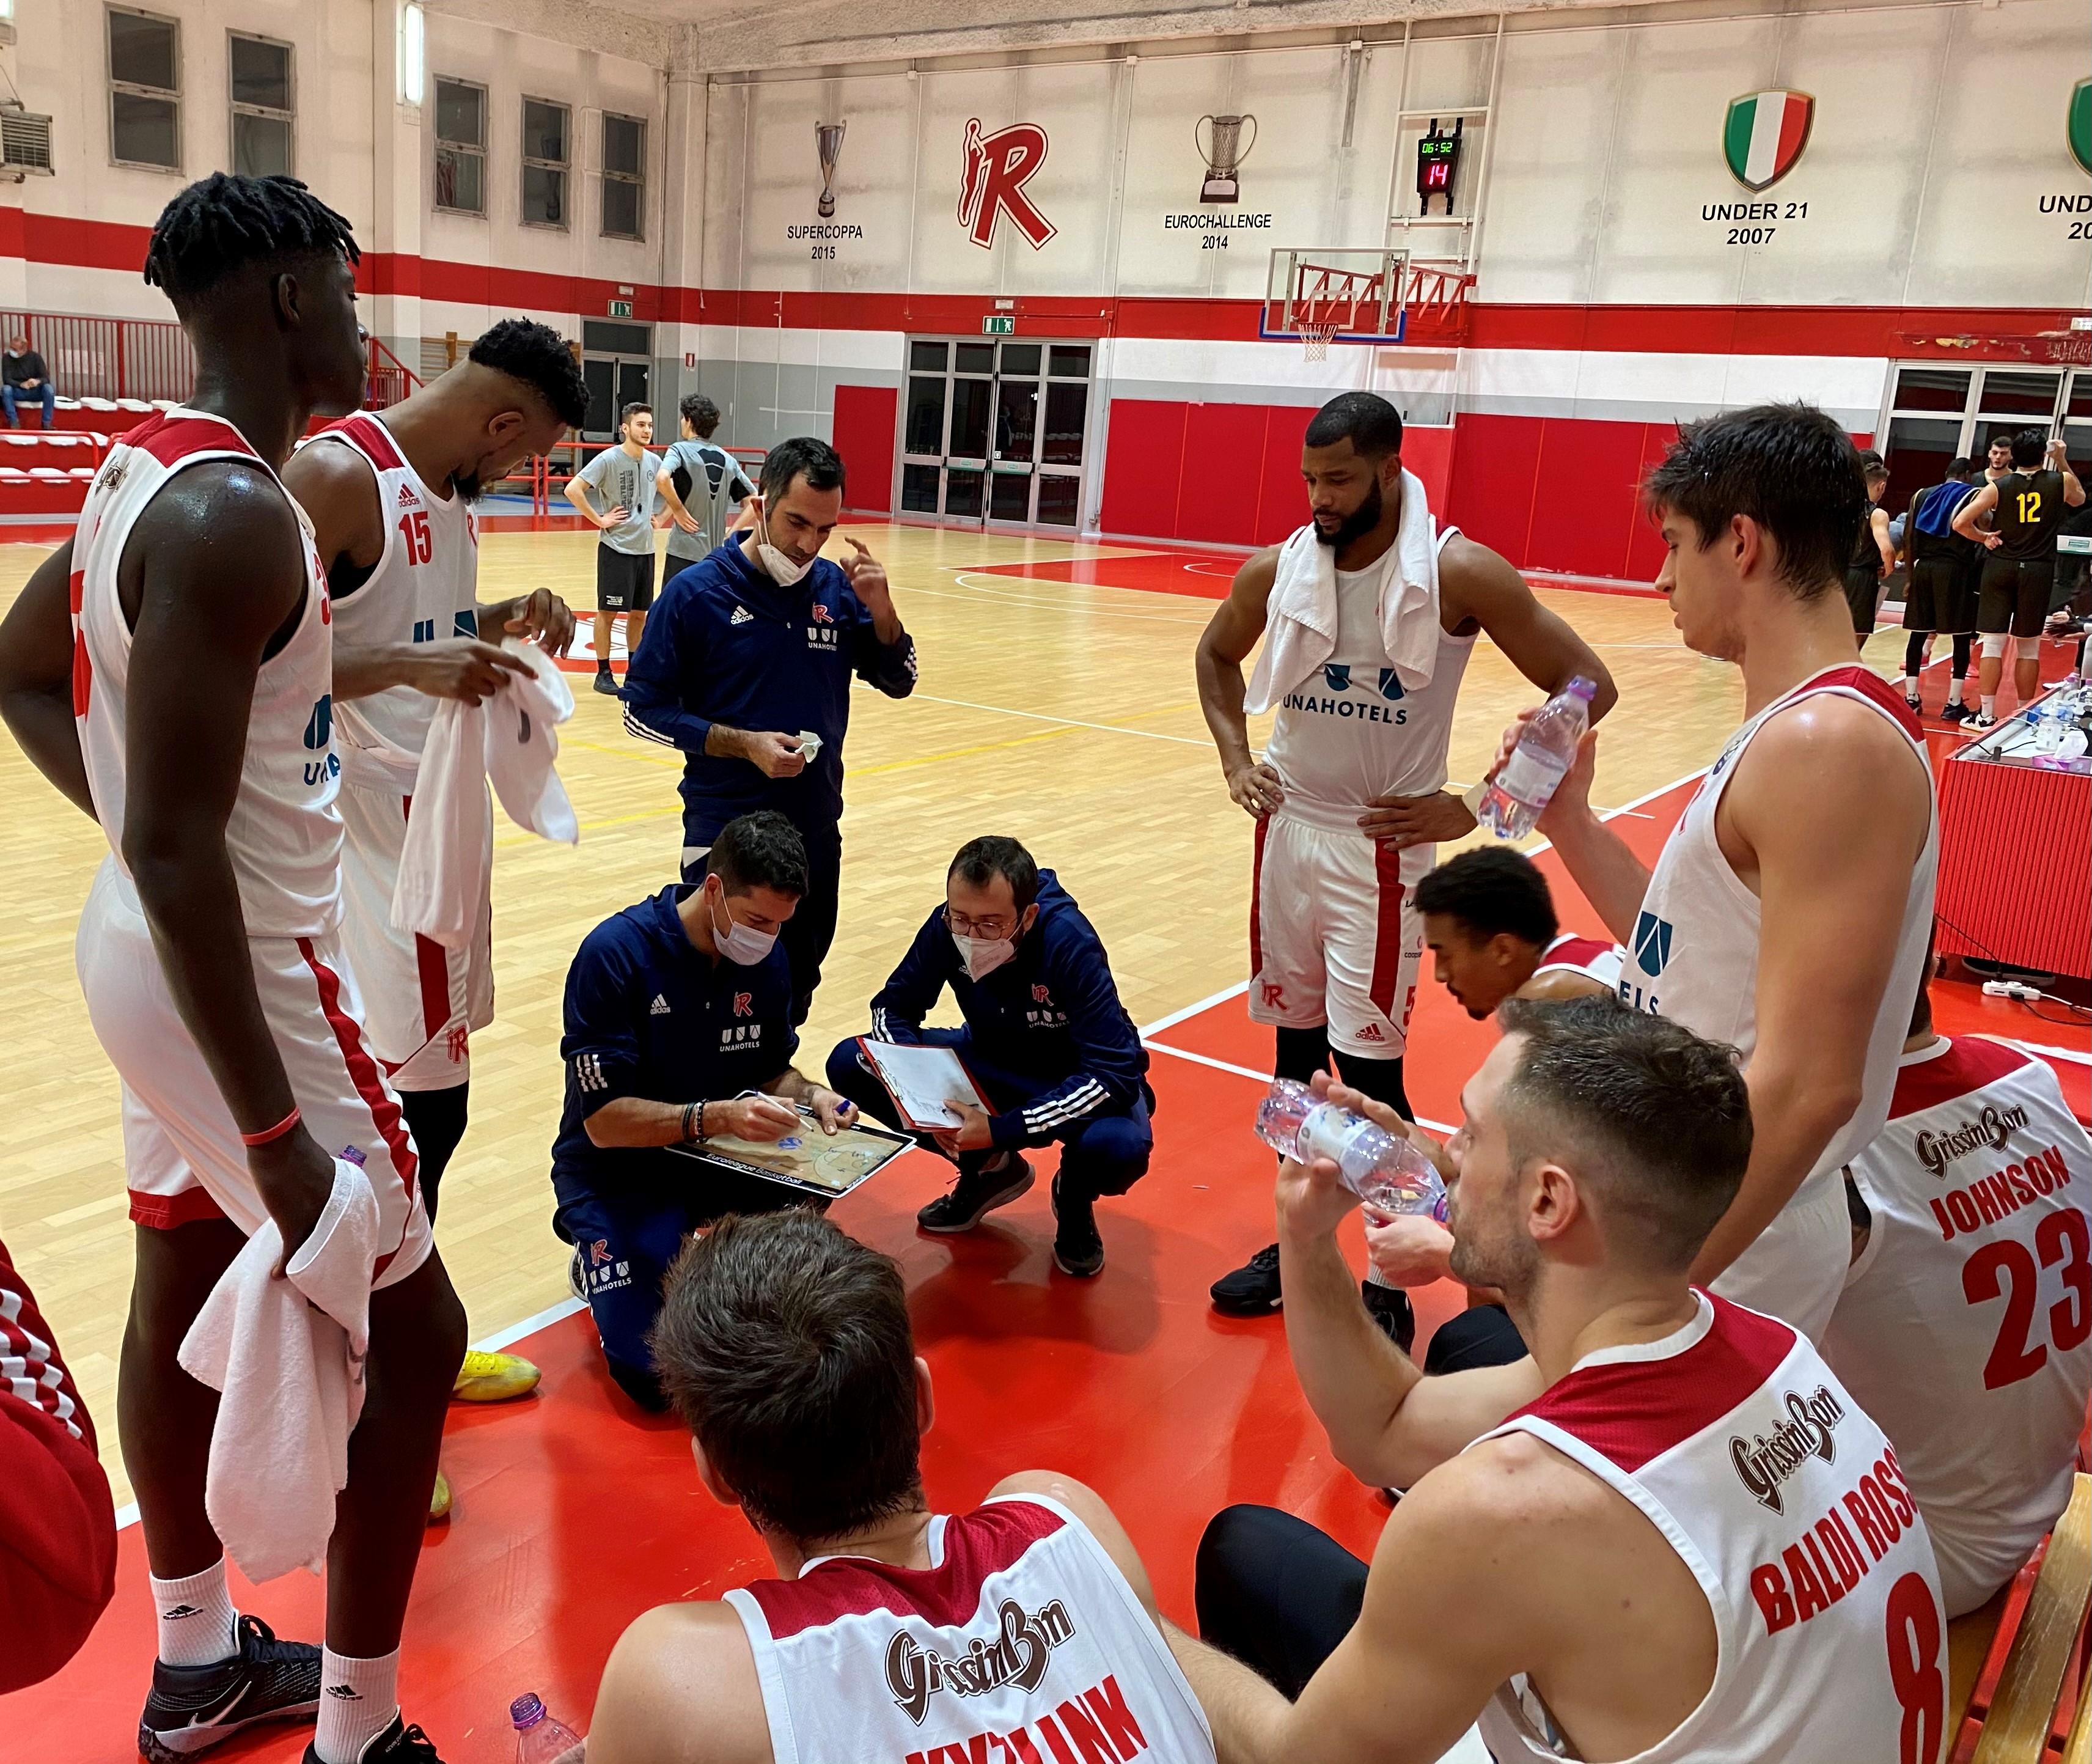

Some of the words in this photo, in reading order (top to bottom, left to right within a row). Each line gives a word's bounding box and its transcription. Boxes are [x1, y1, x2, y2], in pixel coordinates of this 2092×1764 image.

[1429, 164, 1448, 185] 14
[1702, 203, 1778, 221] UNDER
[1784, 202, 1808, 219] 21
[2039, 195, 2092, 213] UND
[1164, 214, 1272, 229] EUROCHALLENGE
[787, 225, 863, 239] SUPERCOPPA
[1727, 228, 1776, 244] 2007
[1202, 235, 1228, 249] 2014
[811, 246, 836, 259] 2015
[398, 497, 420, 507] adidas
[2016, 491, 2041, 523] 12
[398, 510, 432, 567] 15
[730, 614, 754, 625] adidas
[1283, 694, 1408, 726] UNAHOTELS
[1355, 1032, 1385, 1042] adidas
[719, 1041, 760, 1052] UNAHOTELS
[706, 1153, 756, 1172] Euroleague
[1929, 1145, 2072, 1241] JOHNSON
[1962, 1207, 2092, 1391] 23
[1750, 1506, 1870, 1637] BALDI
[1841, 1441, 1918, 1563] ROSS
[1885, 1571, 1944, 1764] 8
